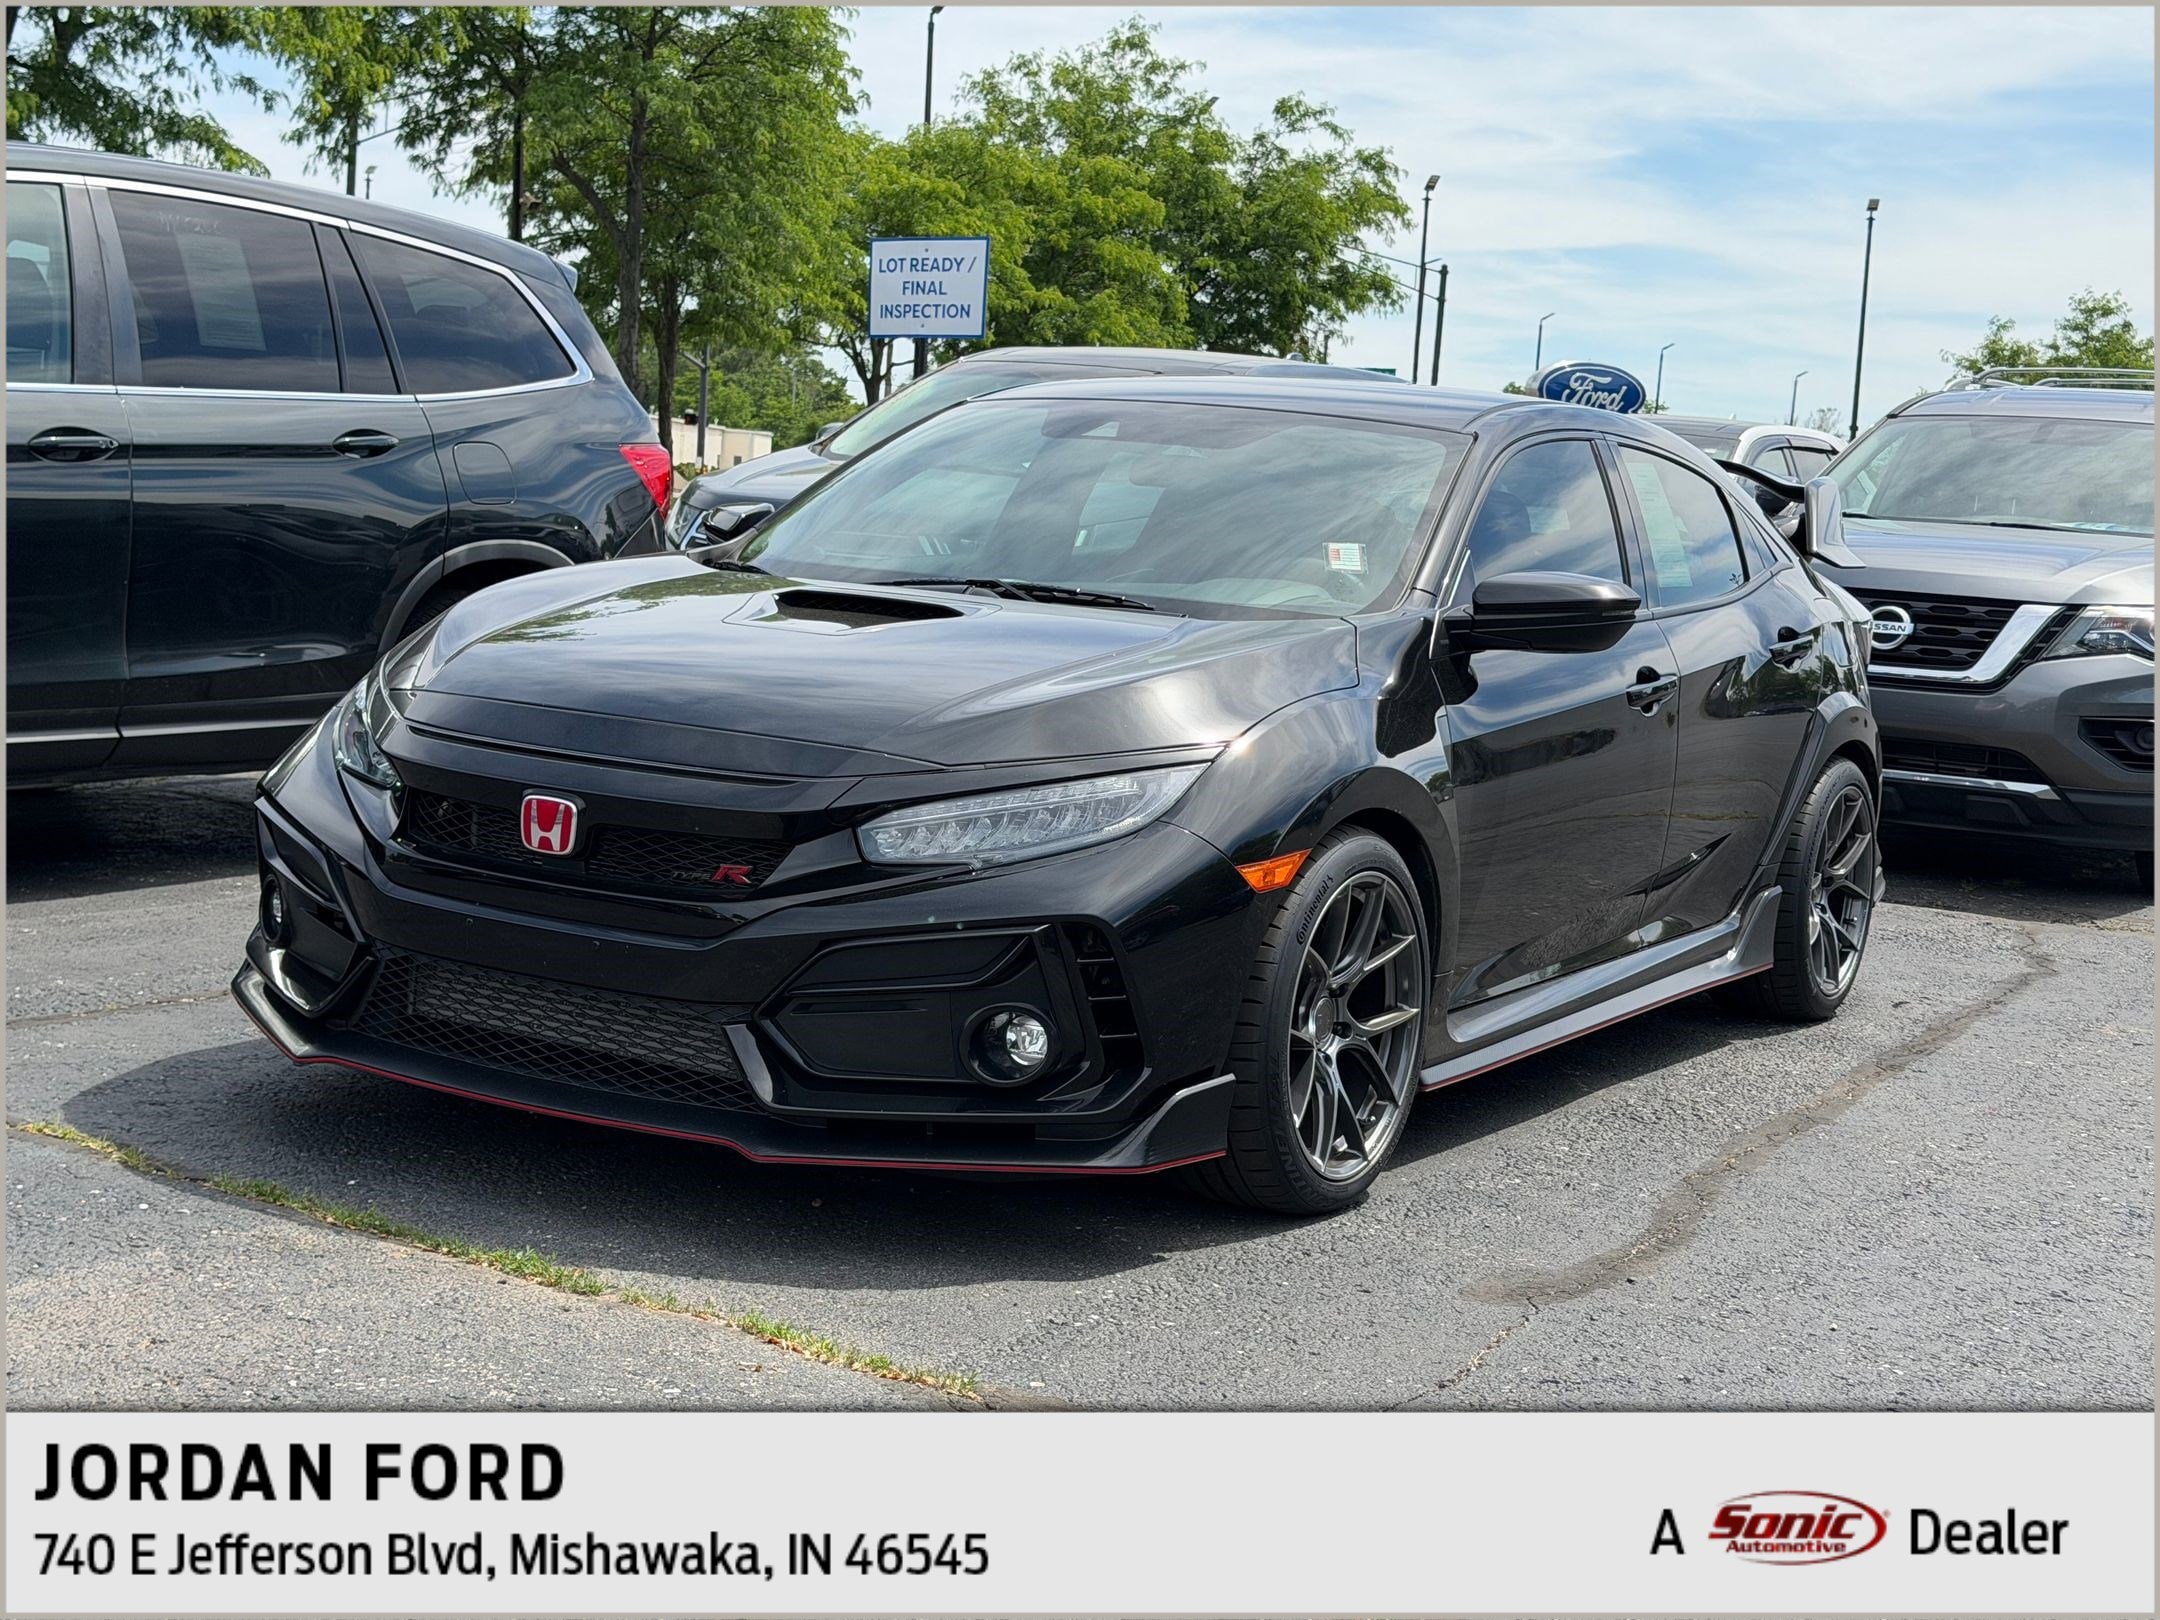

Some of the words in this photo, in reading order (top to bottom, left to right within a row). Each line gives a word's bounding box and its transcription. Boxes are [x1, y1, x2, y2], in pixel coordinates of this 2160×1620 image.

[878, 257, 907, 274] LOT
[909, 257, 965, 273] READY
[902, 280, 948, 296] FINAL
[879, 303, 971, 319] INSPECTION
[1561, 372, 1628, 412] Ford
[671, 870, 711, 881] TYPE
[710, 863, 754, 886] R
[1296, 879, 1331, 946] Continental
